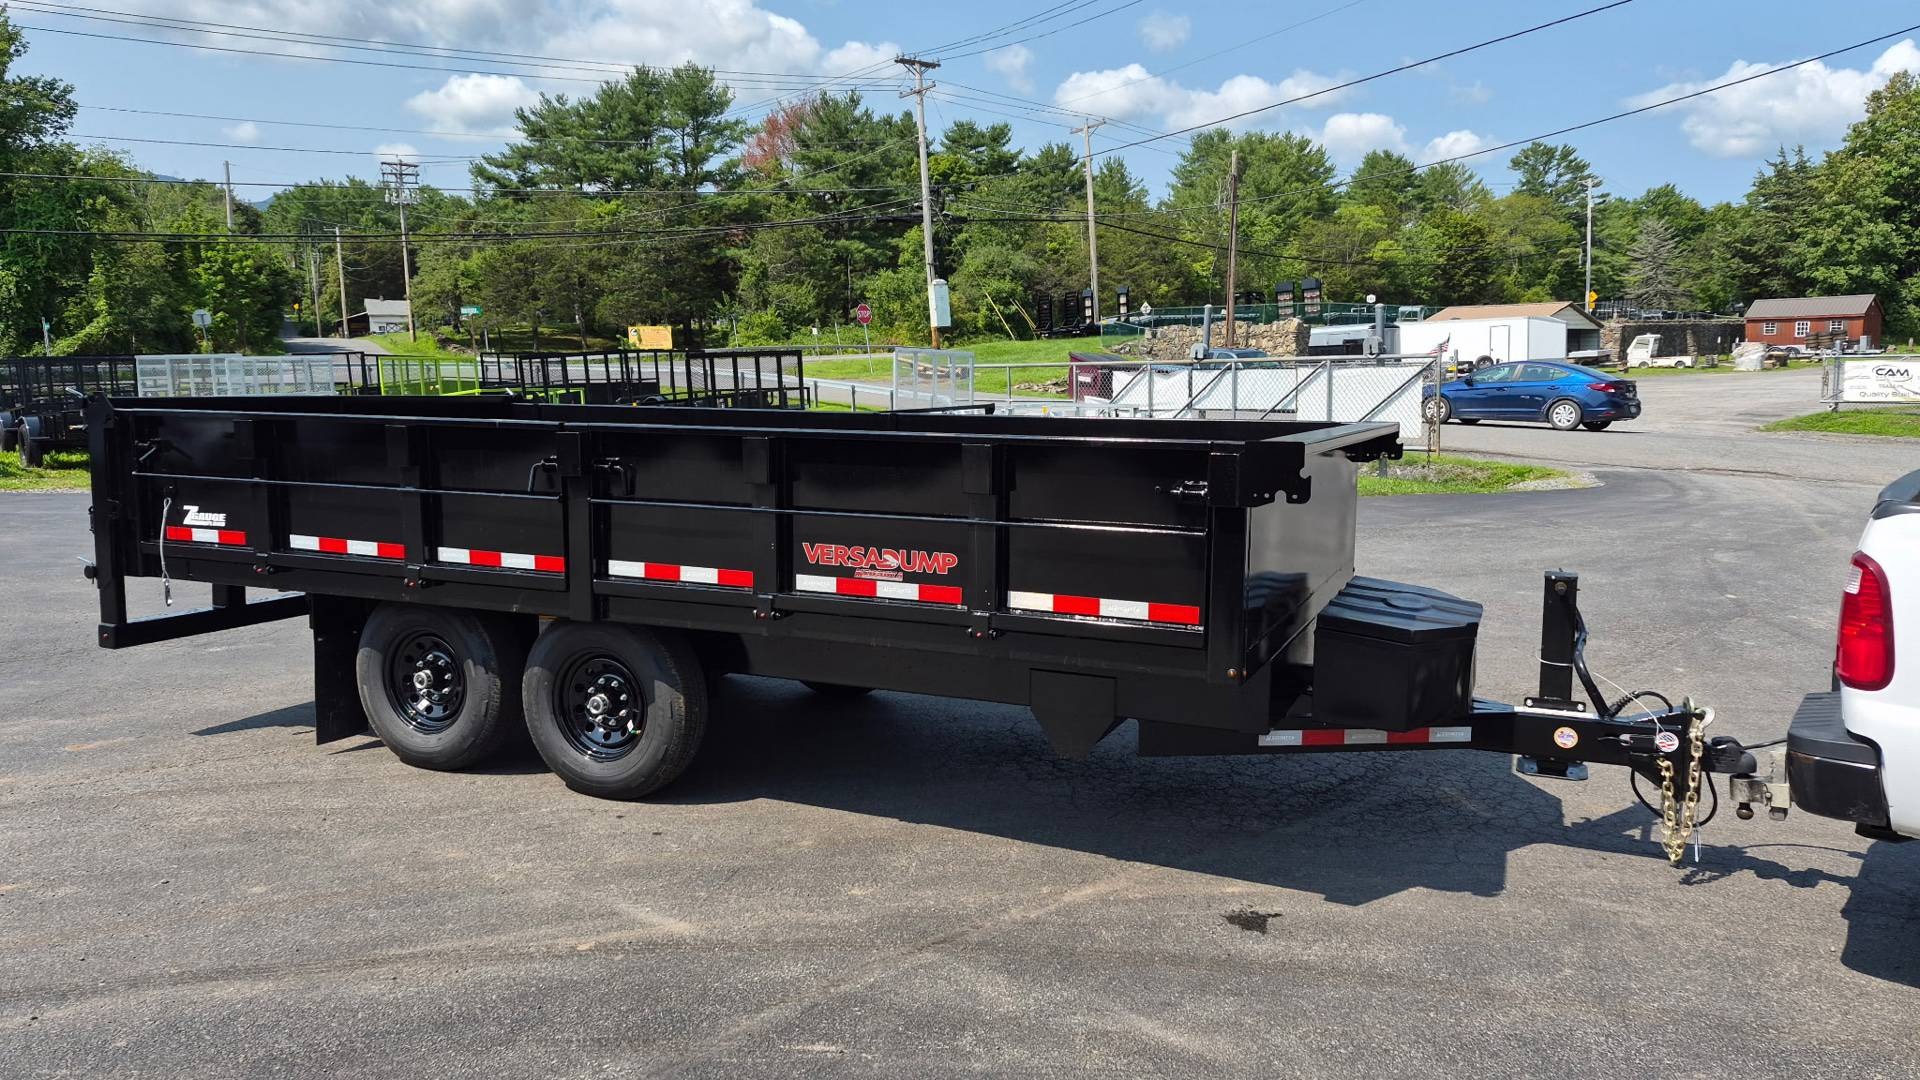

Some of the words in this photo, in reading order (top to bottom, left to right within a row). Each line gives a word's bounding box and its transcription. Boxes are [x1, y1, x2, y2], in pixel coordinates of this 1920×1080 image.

[857, 310, 871, 318] STOP
[1876, 368, 1910, 377] CAM
[802, 542, 958, 575] VERSADUMP
